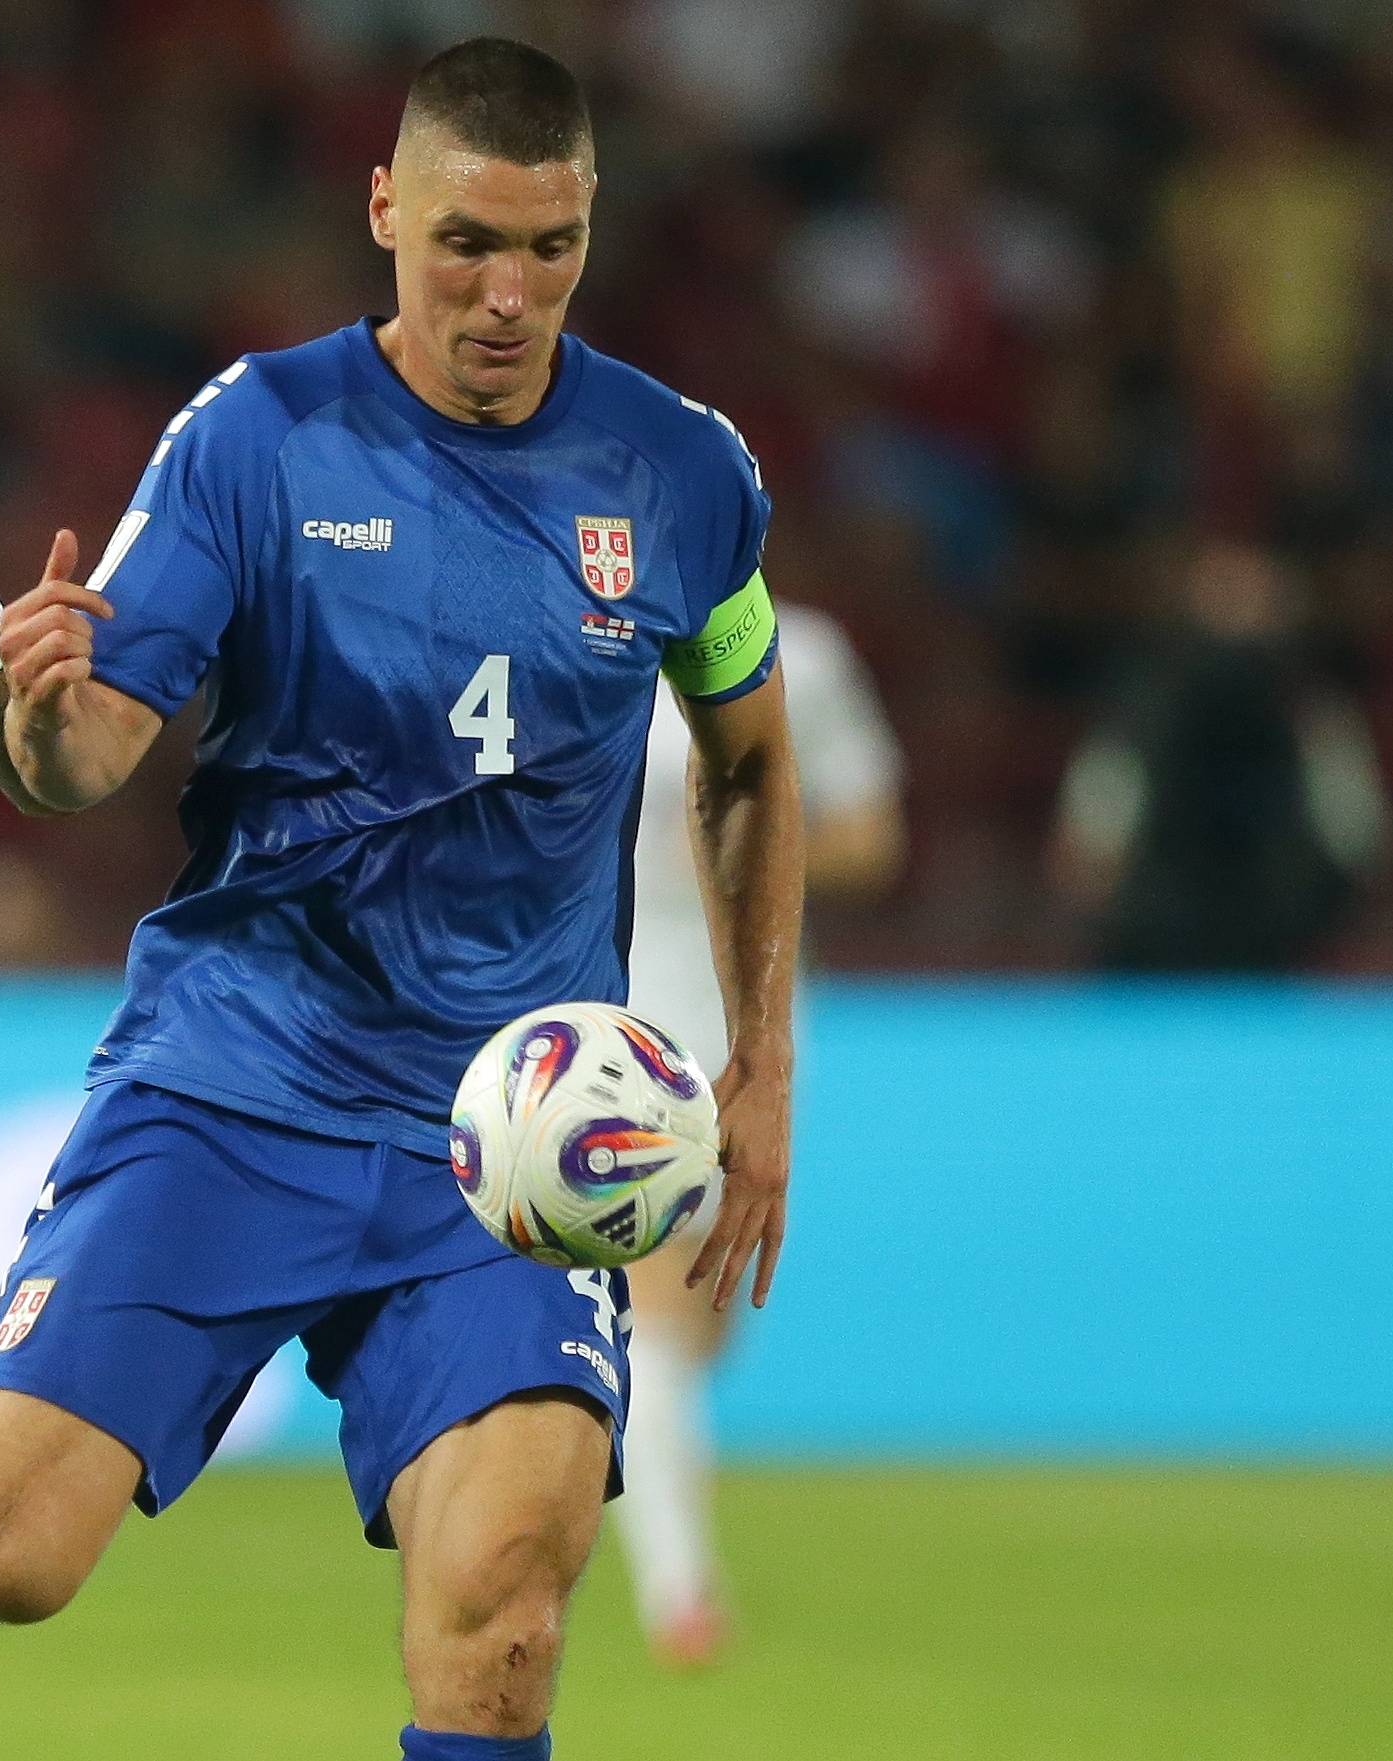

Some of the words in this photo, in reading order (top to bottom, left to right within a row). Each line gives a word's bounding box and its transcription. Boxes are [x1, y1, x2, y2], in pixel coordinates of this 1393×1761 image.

[303, 518, 392, 546] capelli
[342, 540, 391, 551] SPORT
[685, 603, 756, 661] RESPECT
[448, 655, 514, 774] 4
